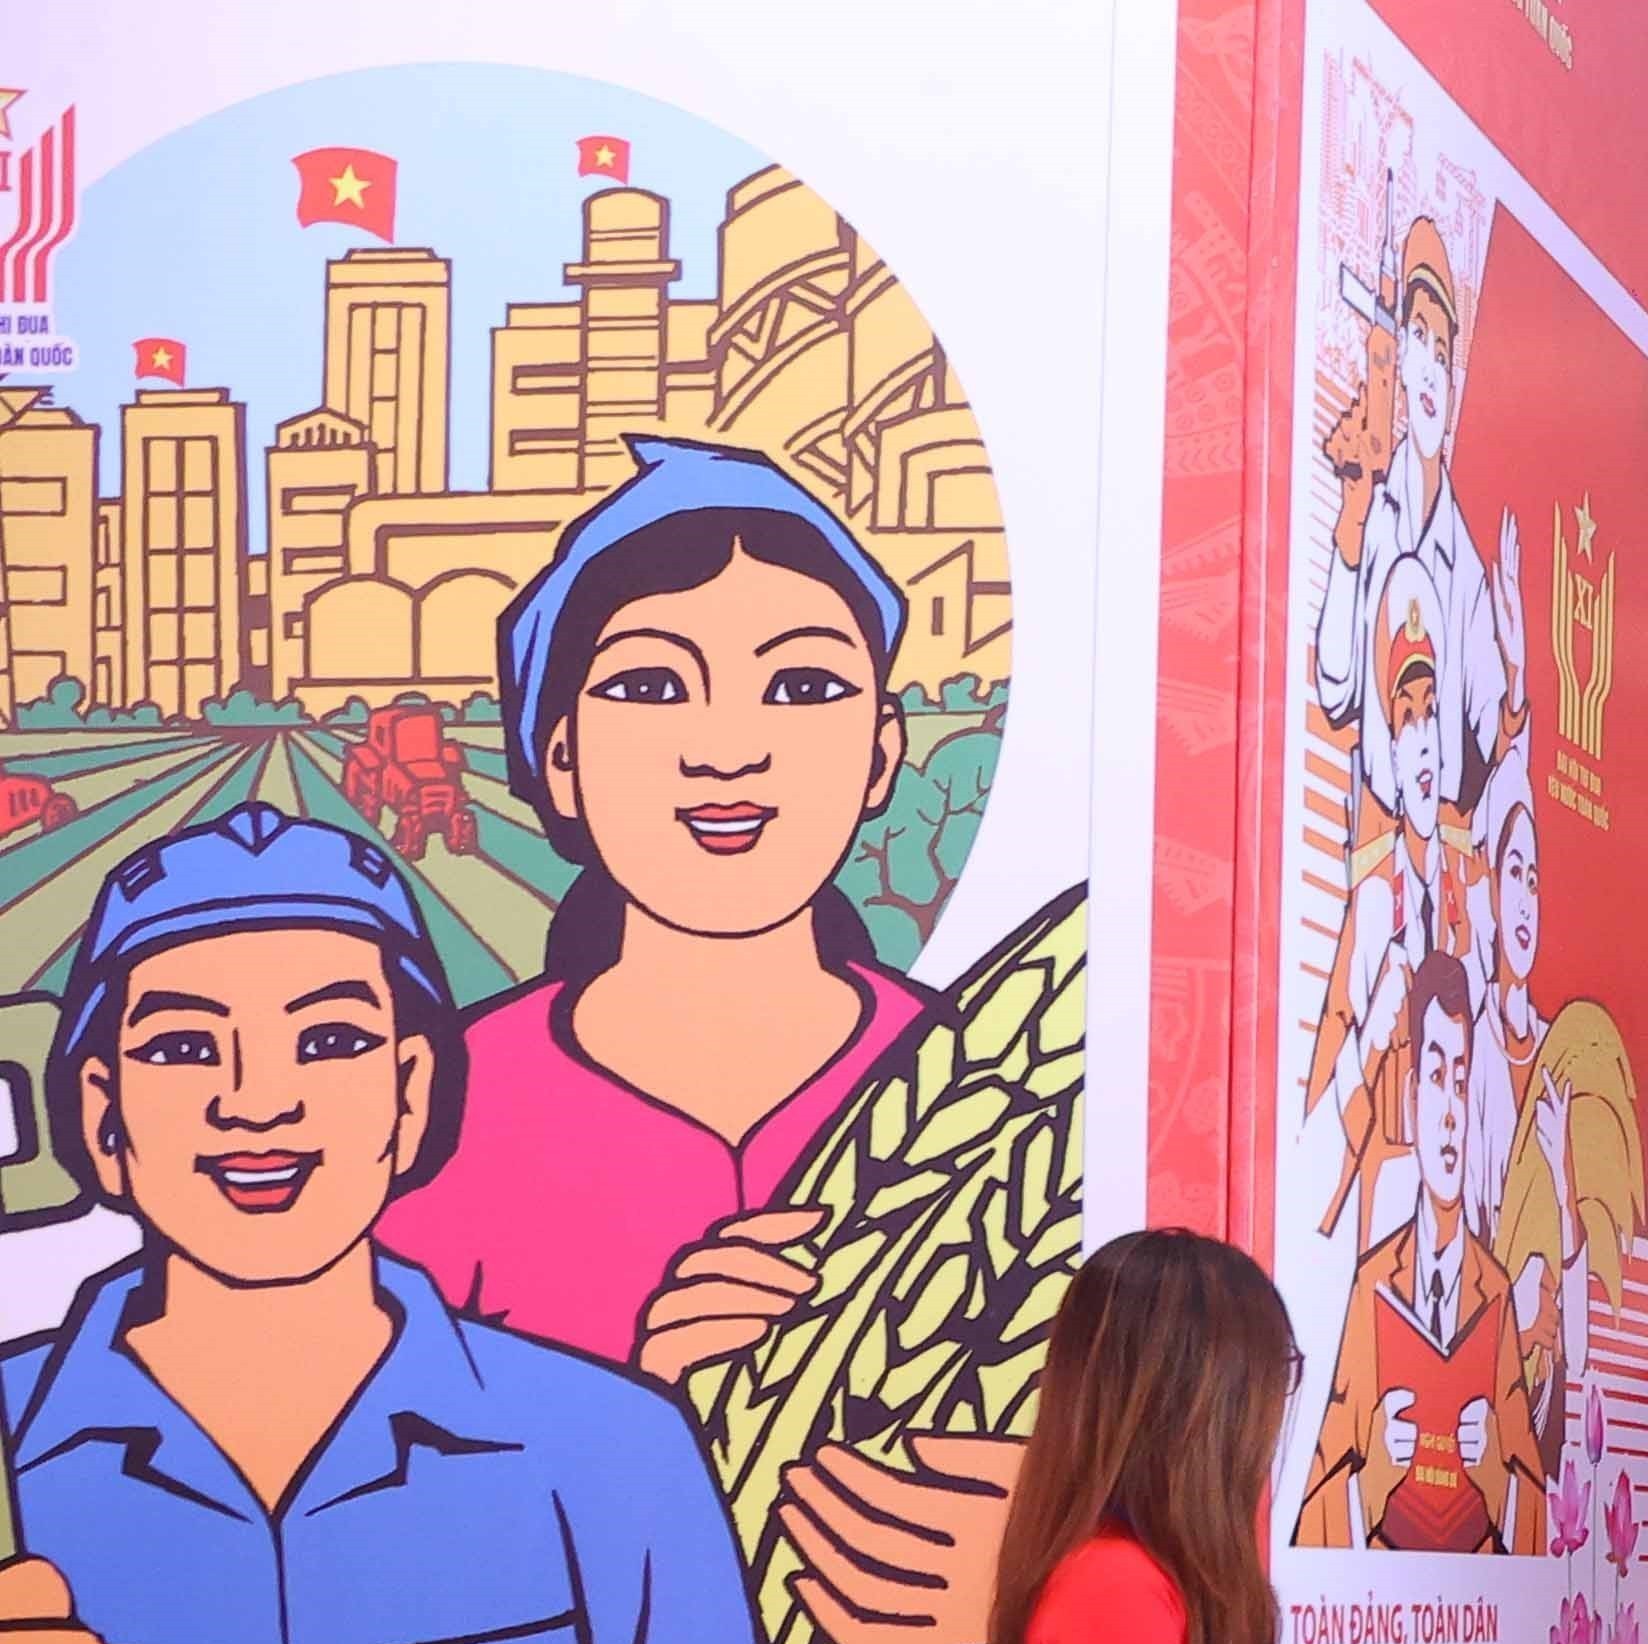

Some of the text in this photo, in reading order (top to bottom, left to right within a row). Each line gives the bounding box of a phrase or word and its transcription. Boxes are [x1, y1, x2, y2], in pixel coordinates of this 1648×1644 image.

[0, 342, 72, 366] ÀN QUỐC
[1412, 1595, 1458, 1644] TOÀN
[1463, 1596, 1498, 1643] DÂN
